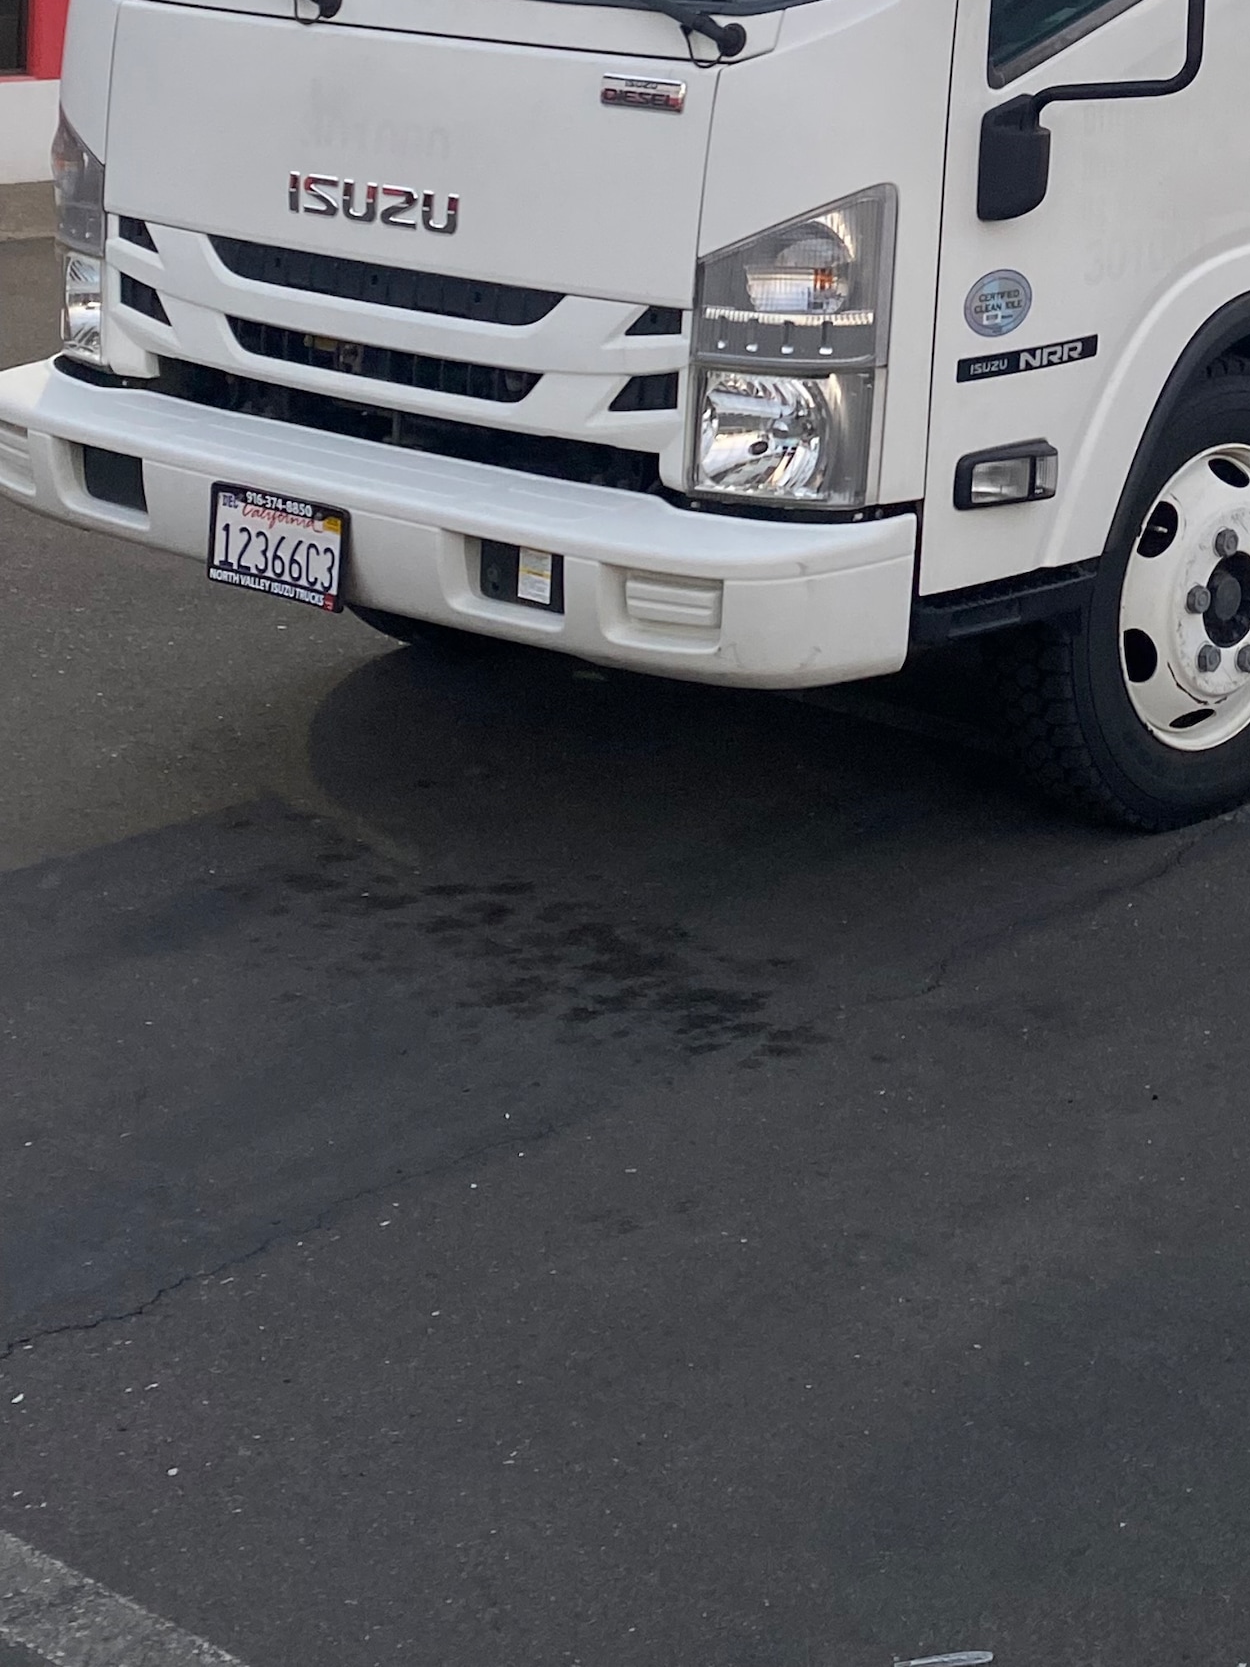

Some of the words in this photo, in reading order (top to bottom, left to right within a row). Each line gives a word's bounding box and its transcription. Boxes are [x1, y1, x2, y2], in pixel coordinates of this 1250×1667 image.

[603, 88, 680, 110] DIESEL
[289, 171, 459, 234] ISUZU
[974, 303, 1002, 315] CLEAN
[1005, 299, 1023, 310] IDLE
[978, 289, 1020, 303] CERTIFIED
[970, 358, 1008, 375] ISUZU
[1019, 341, 1083, 370] NRR
[219, 522, 335, 593] 12366C3
[209, 567, 240, 585] NORTH
[240, 574, 271, 591] VALLEY
[271, 582, 295, 598] ISUZU
[296, 588, 325, 607] TRUCKS
